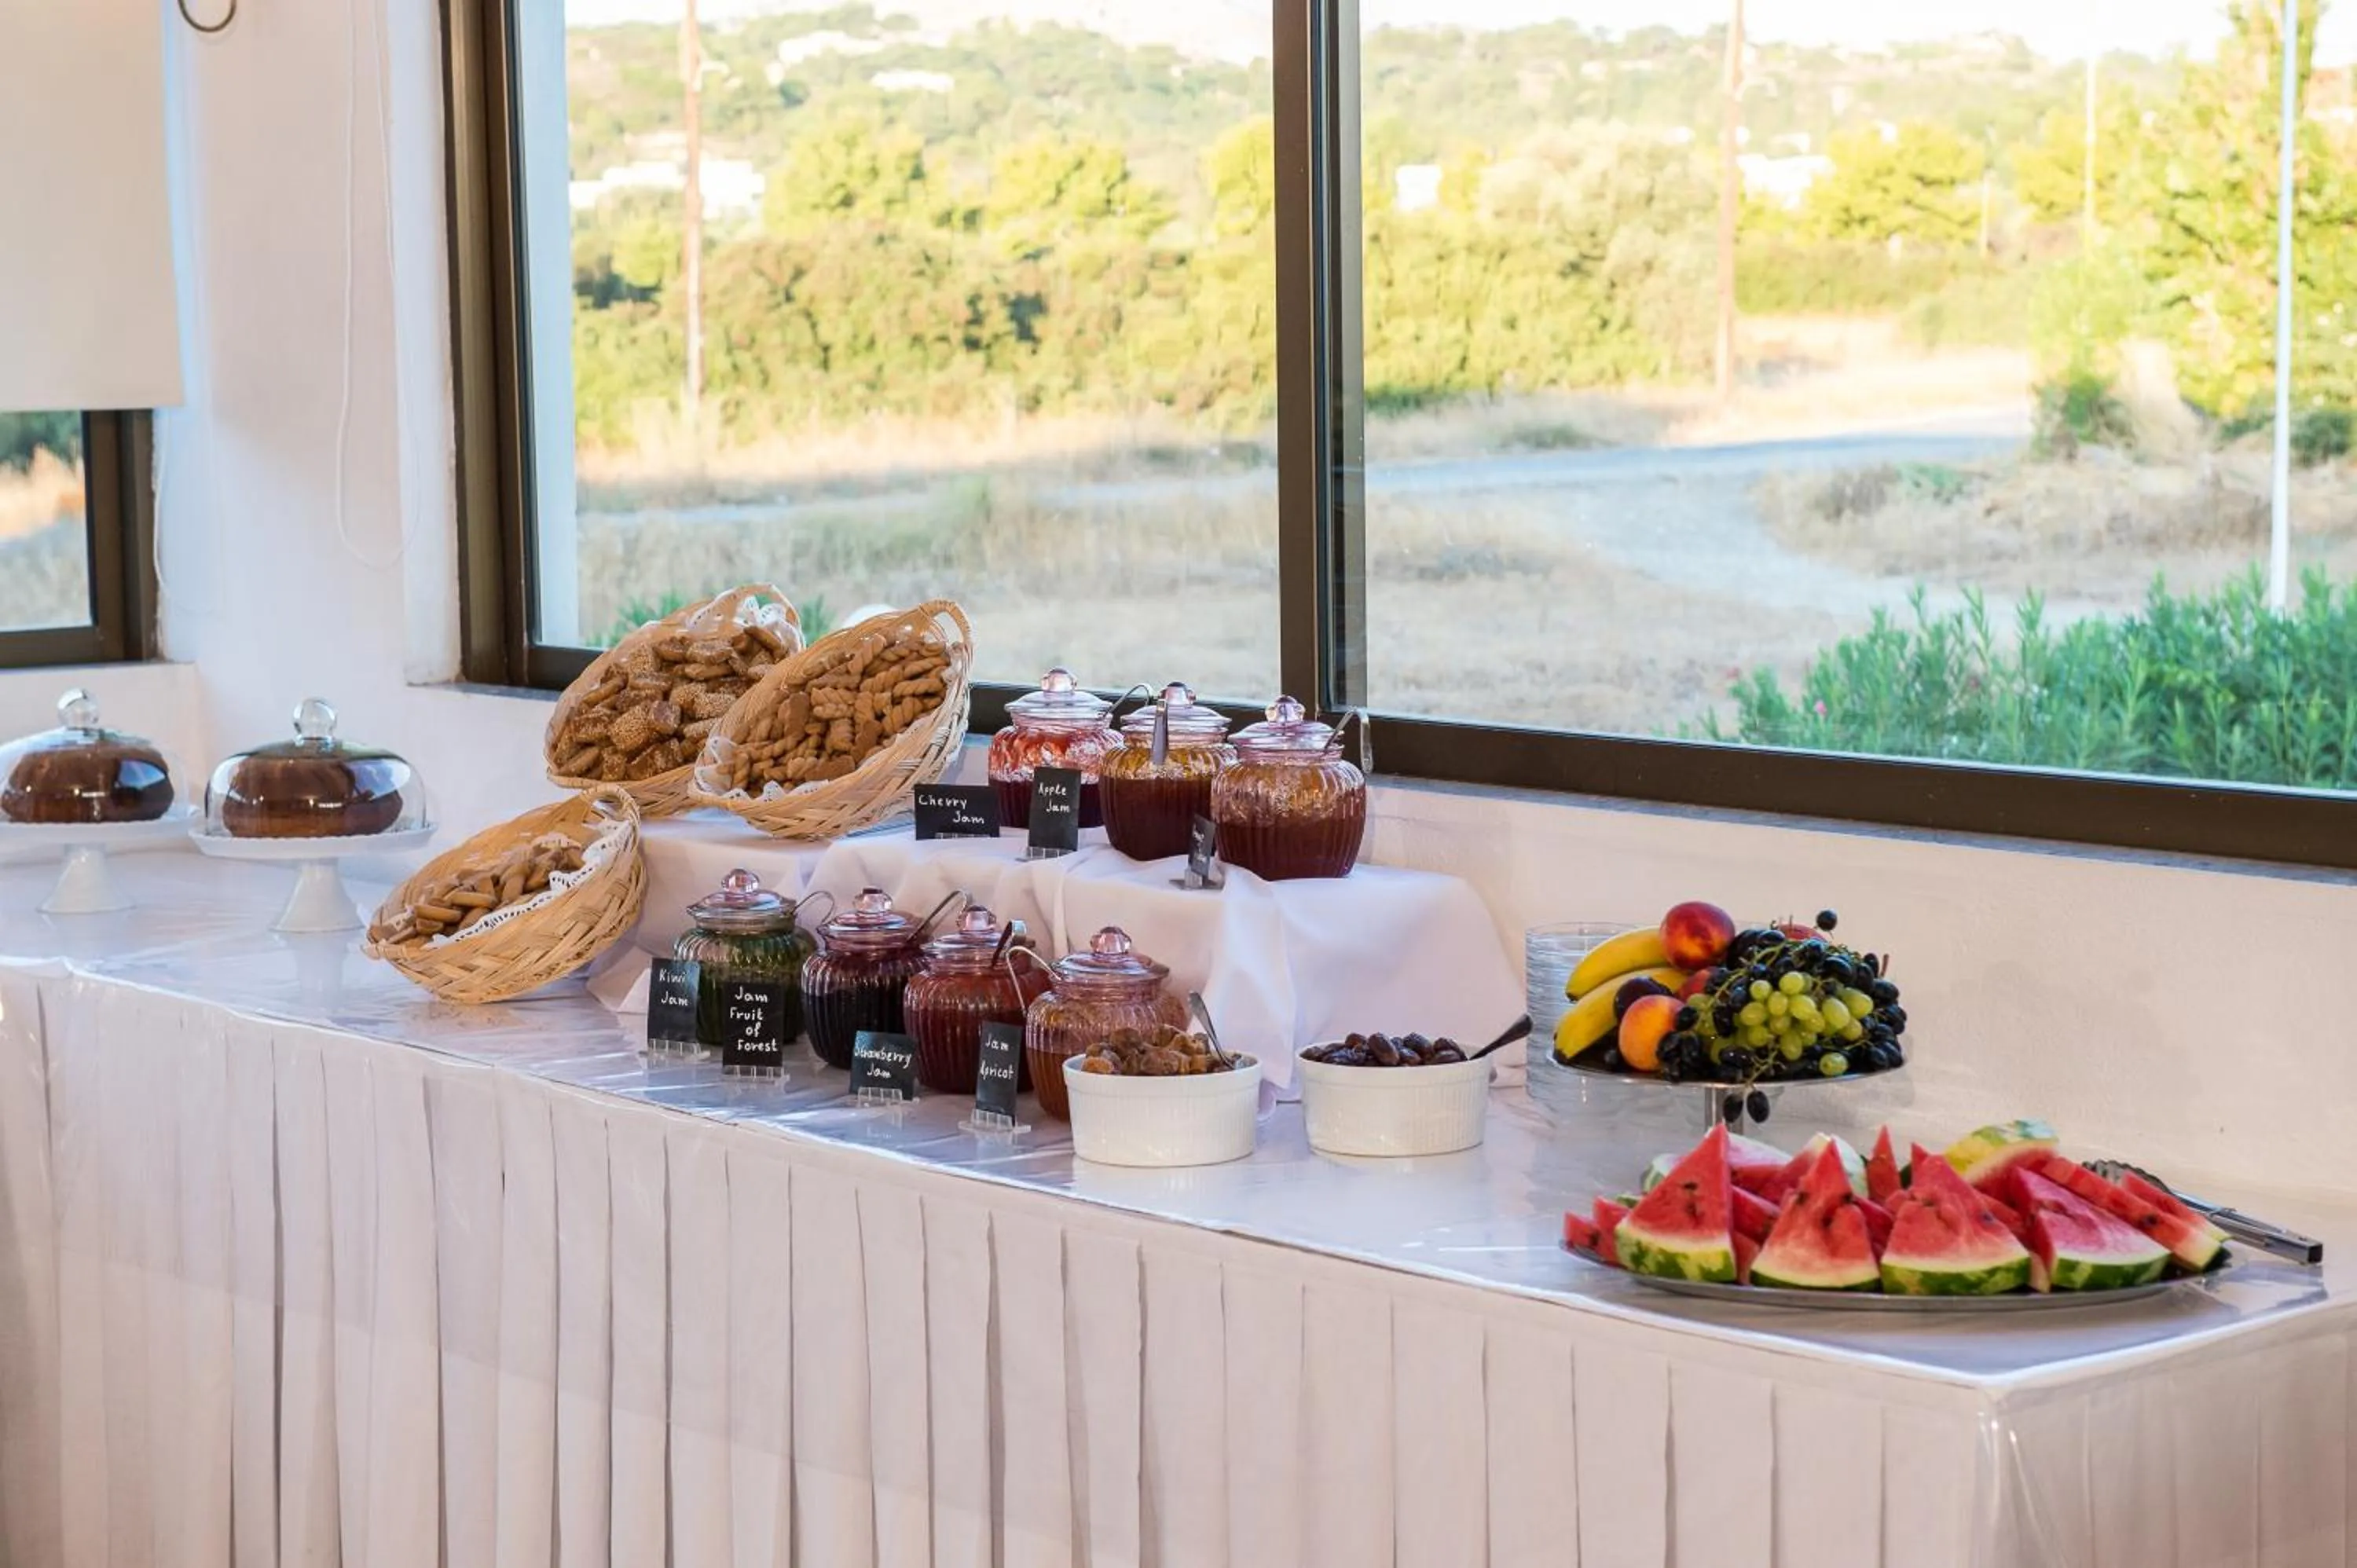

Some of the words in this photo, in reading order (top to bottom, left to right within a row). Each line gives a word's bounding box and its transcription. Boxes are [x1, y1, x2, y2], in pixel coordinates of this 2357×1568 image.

[1038, 782, 1067, 797] Apple
[918, 793, 967, 810] Cherry
[1046, 798, 1070, 813] Jam
[953, 810, 985, 824] Jam
[659, 968, 686, 983] Kiwi
[661, 991, 689, 1006] Jam
[735, 985, 768, 1002] Jam
[729, 1006, 764, 1020] Fruit
[746, 1020, 761, 1038] of
[737, 1038, 779, 1052] Forest
[984, 1032, 1010, 1051] Jam
[866, 1061, 892, 1079] Jam
[980, 1060, 1014, 1081] Apricot
